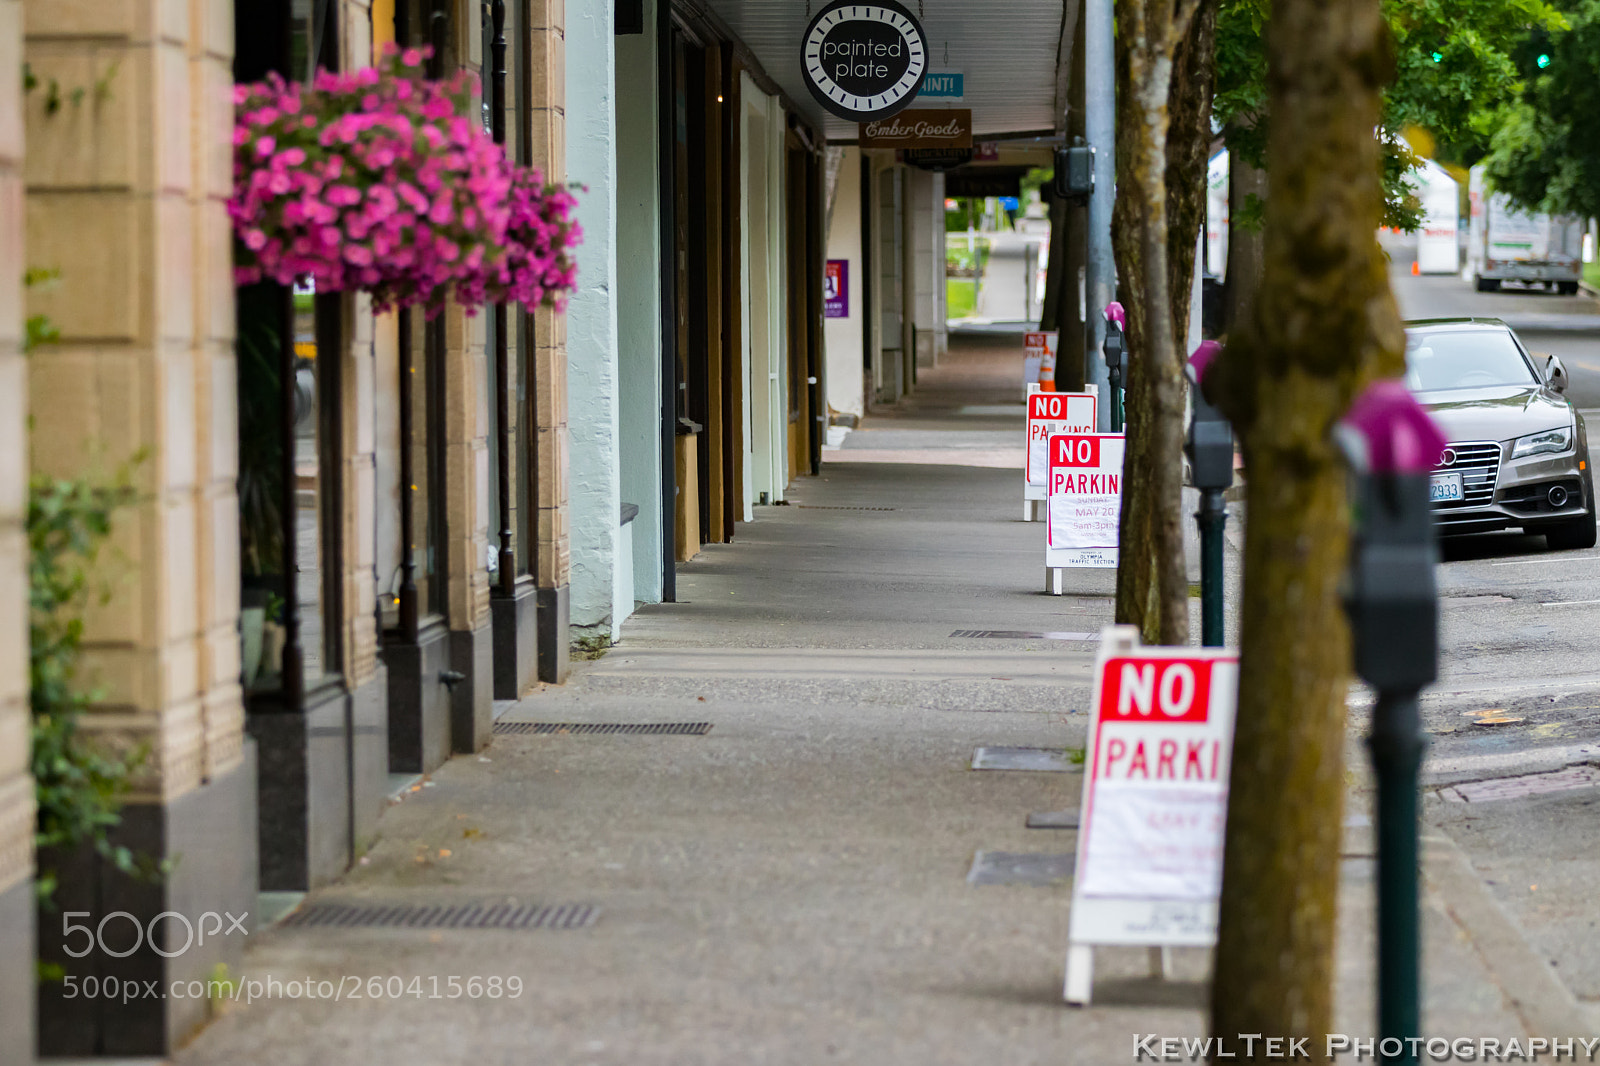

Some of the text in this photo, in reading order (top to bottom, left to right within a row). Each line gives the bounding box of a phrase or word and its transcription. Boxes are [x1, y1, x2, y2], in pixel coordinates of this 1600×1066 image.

[824, 36, 901, 60] painted
[835, 56, 888, 81] plate
[865, 119, 965, 139] Ember Goods
[1035, 397, 1061, 417] NO
[1059, 439, 1091, 463] NO
[1055, 473, 1118, 494] PARKIN
[1431, 484, 1457, 498] 2933
[1075, 507, 1114, 517] MAY 20
[1117, 662, 1196, 717] NO
[1104, 739, 1220, 780] PARKI
